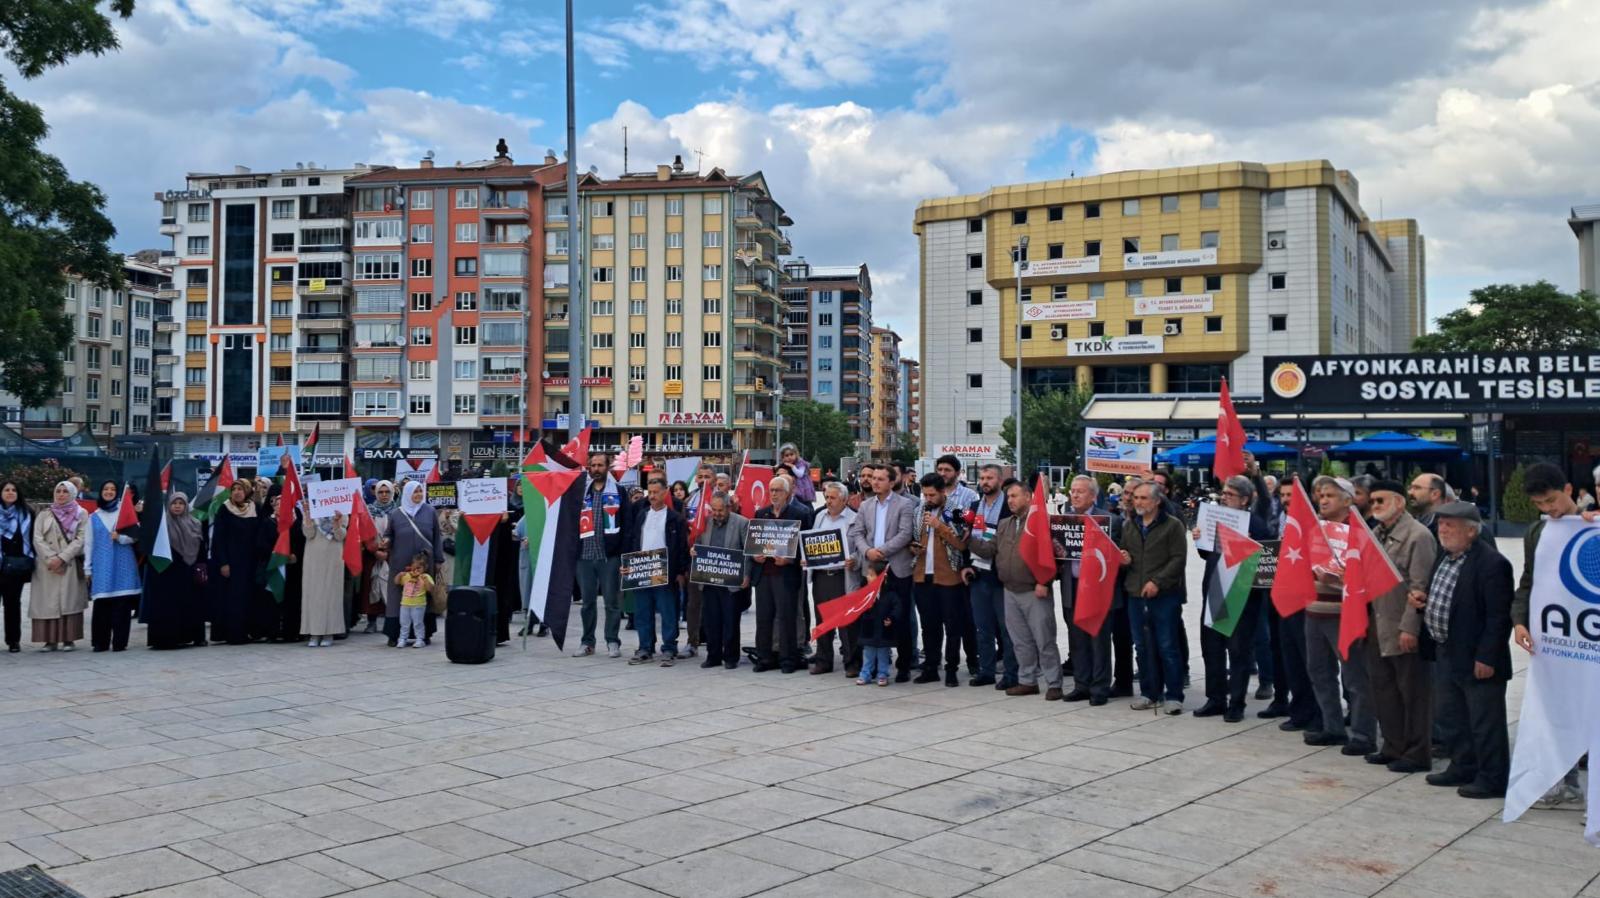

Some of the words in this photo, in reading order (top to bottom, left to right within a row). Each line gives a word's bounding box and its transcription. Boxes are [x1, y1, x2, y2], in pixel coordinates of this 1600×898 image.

[1075, 341, 1113, 352] TKDK
[1311, 354, 1530, 376] AFYONKARAHİSAR
[1539, 356, 1600, 372] BELE
[1361, 380, 1470, 400] SOSYAL
[1478, 375, 1600, 399] TESİSLE
[674, 412, 724, 420] ASYAM
[364, 449, 404, 459] BARA
[473, 445, 495, 456] UZUN
[229, 453, 257, 462] SİGORTA
[755, 538, 788, 546] İSTİYORUZ
[696, 557, 718, 566] ENERJİ
[697, 564, 739, 576] DURDURUN
